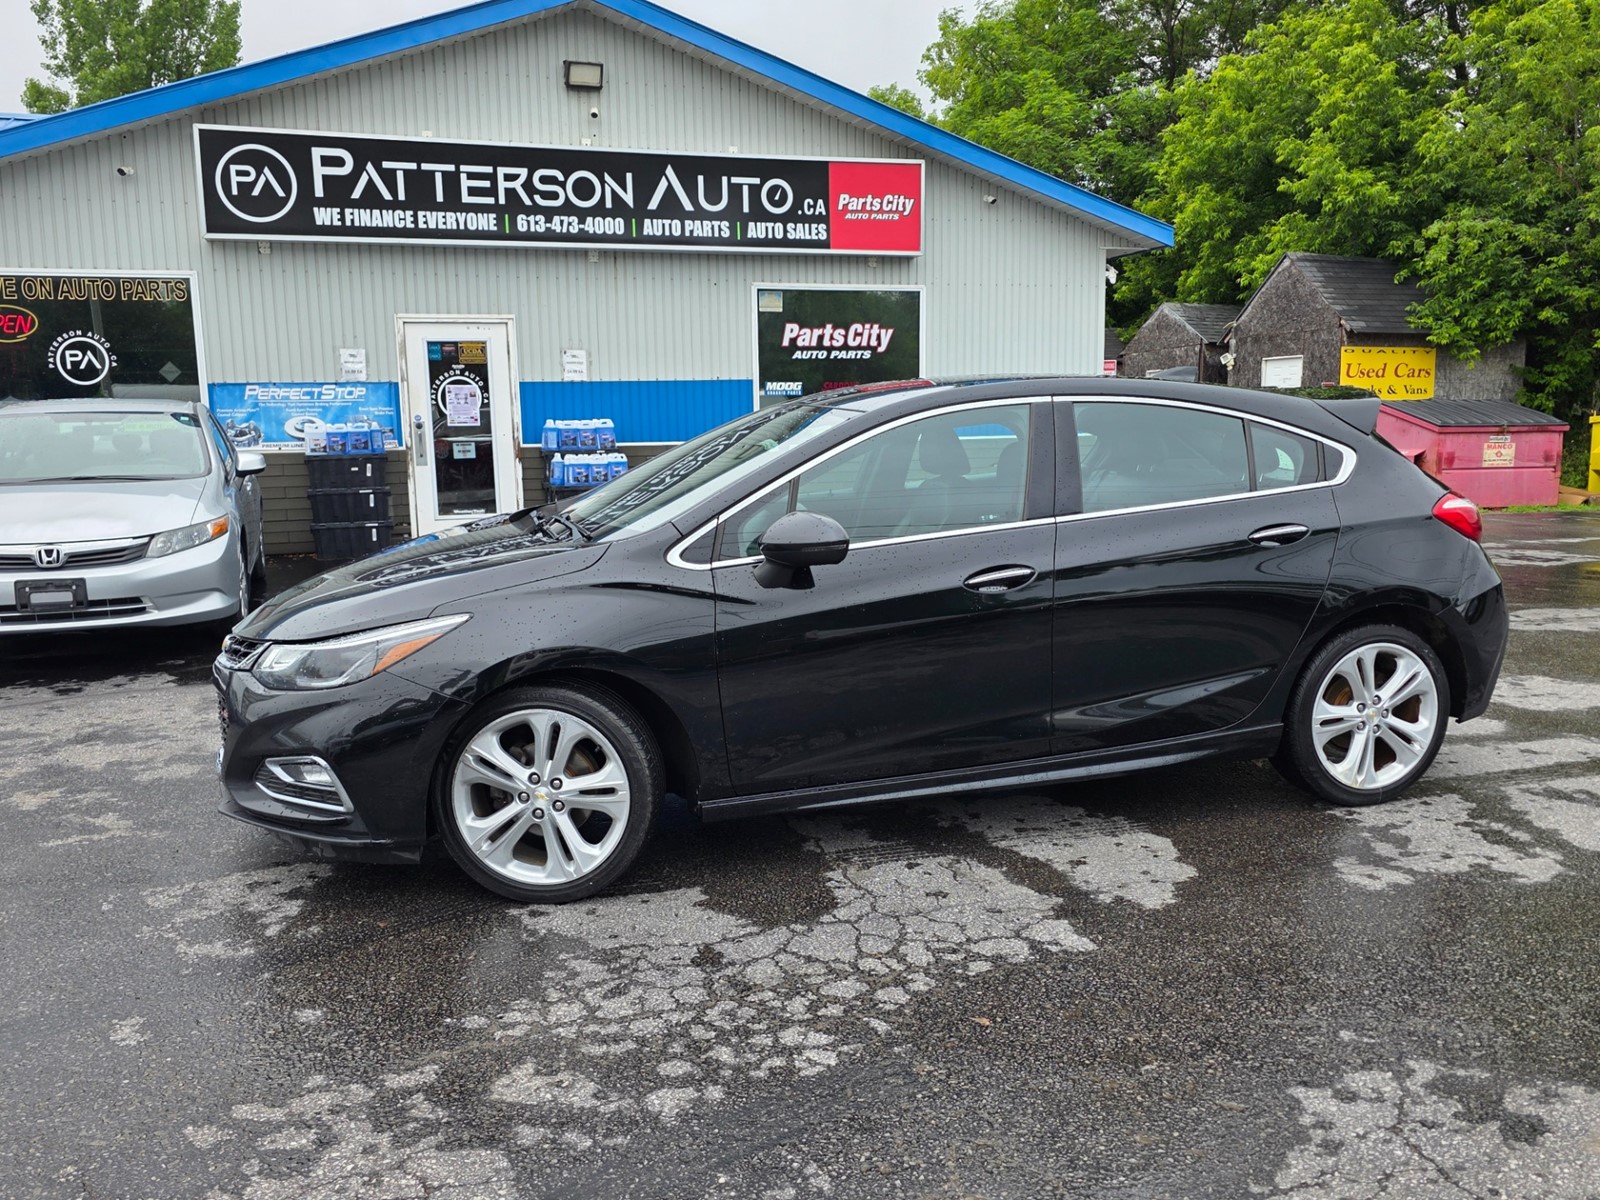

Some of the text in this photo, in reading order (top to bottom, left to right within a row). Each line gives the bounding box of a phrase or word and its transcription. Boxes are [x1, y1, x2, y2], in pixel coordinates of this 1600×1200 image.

[229, 164, 286, 197] PA
[311, 146, 634, 209] PATTERSON
[313, 207, 827, 240] WE FINANCE EVERYONE 613-473-4000 AUTO PARTS AUTO SALES
[871, 213, 899, 221] PARTS
[0, 277, 187, 301] E ON AUTO PARTS
[48, 330, 82, 369] PATTERSON
[86, 331, 111, 349] AUTO
[792, 350, 871, 359] AUTO PARTS
[65, 350, 102, 370] PA
[1346, 362, 1431, 378] Used Cars
[244, 384, 367, 400] PERFECTSTOP
[431, 369, 461, 405] PATTERSON
[464, 370, 484, 387] AUTO
[765, 381, 803, 390] MOOG
[1387, 385, 1398, 395] &
[1404, 385, 1428, 395] Vans
